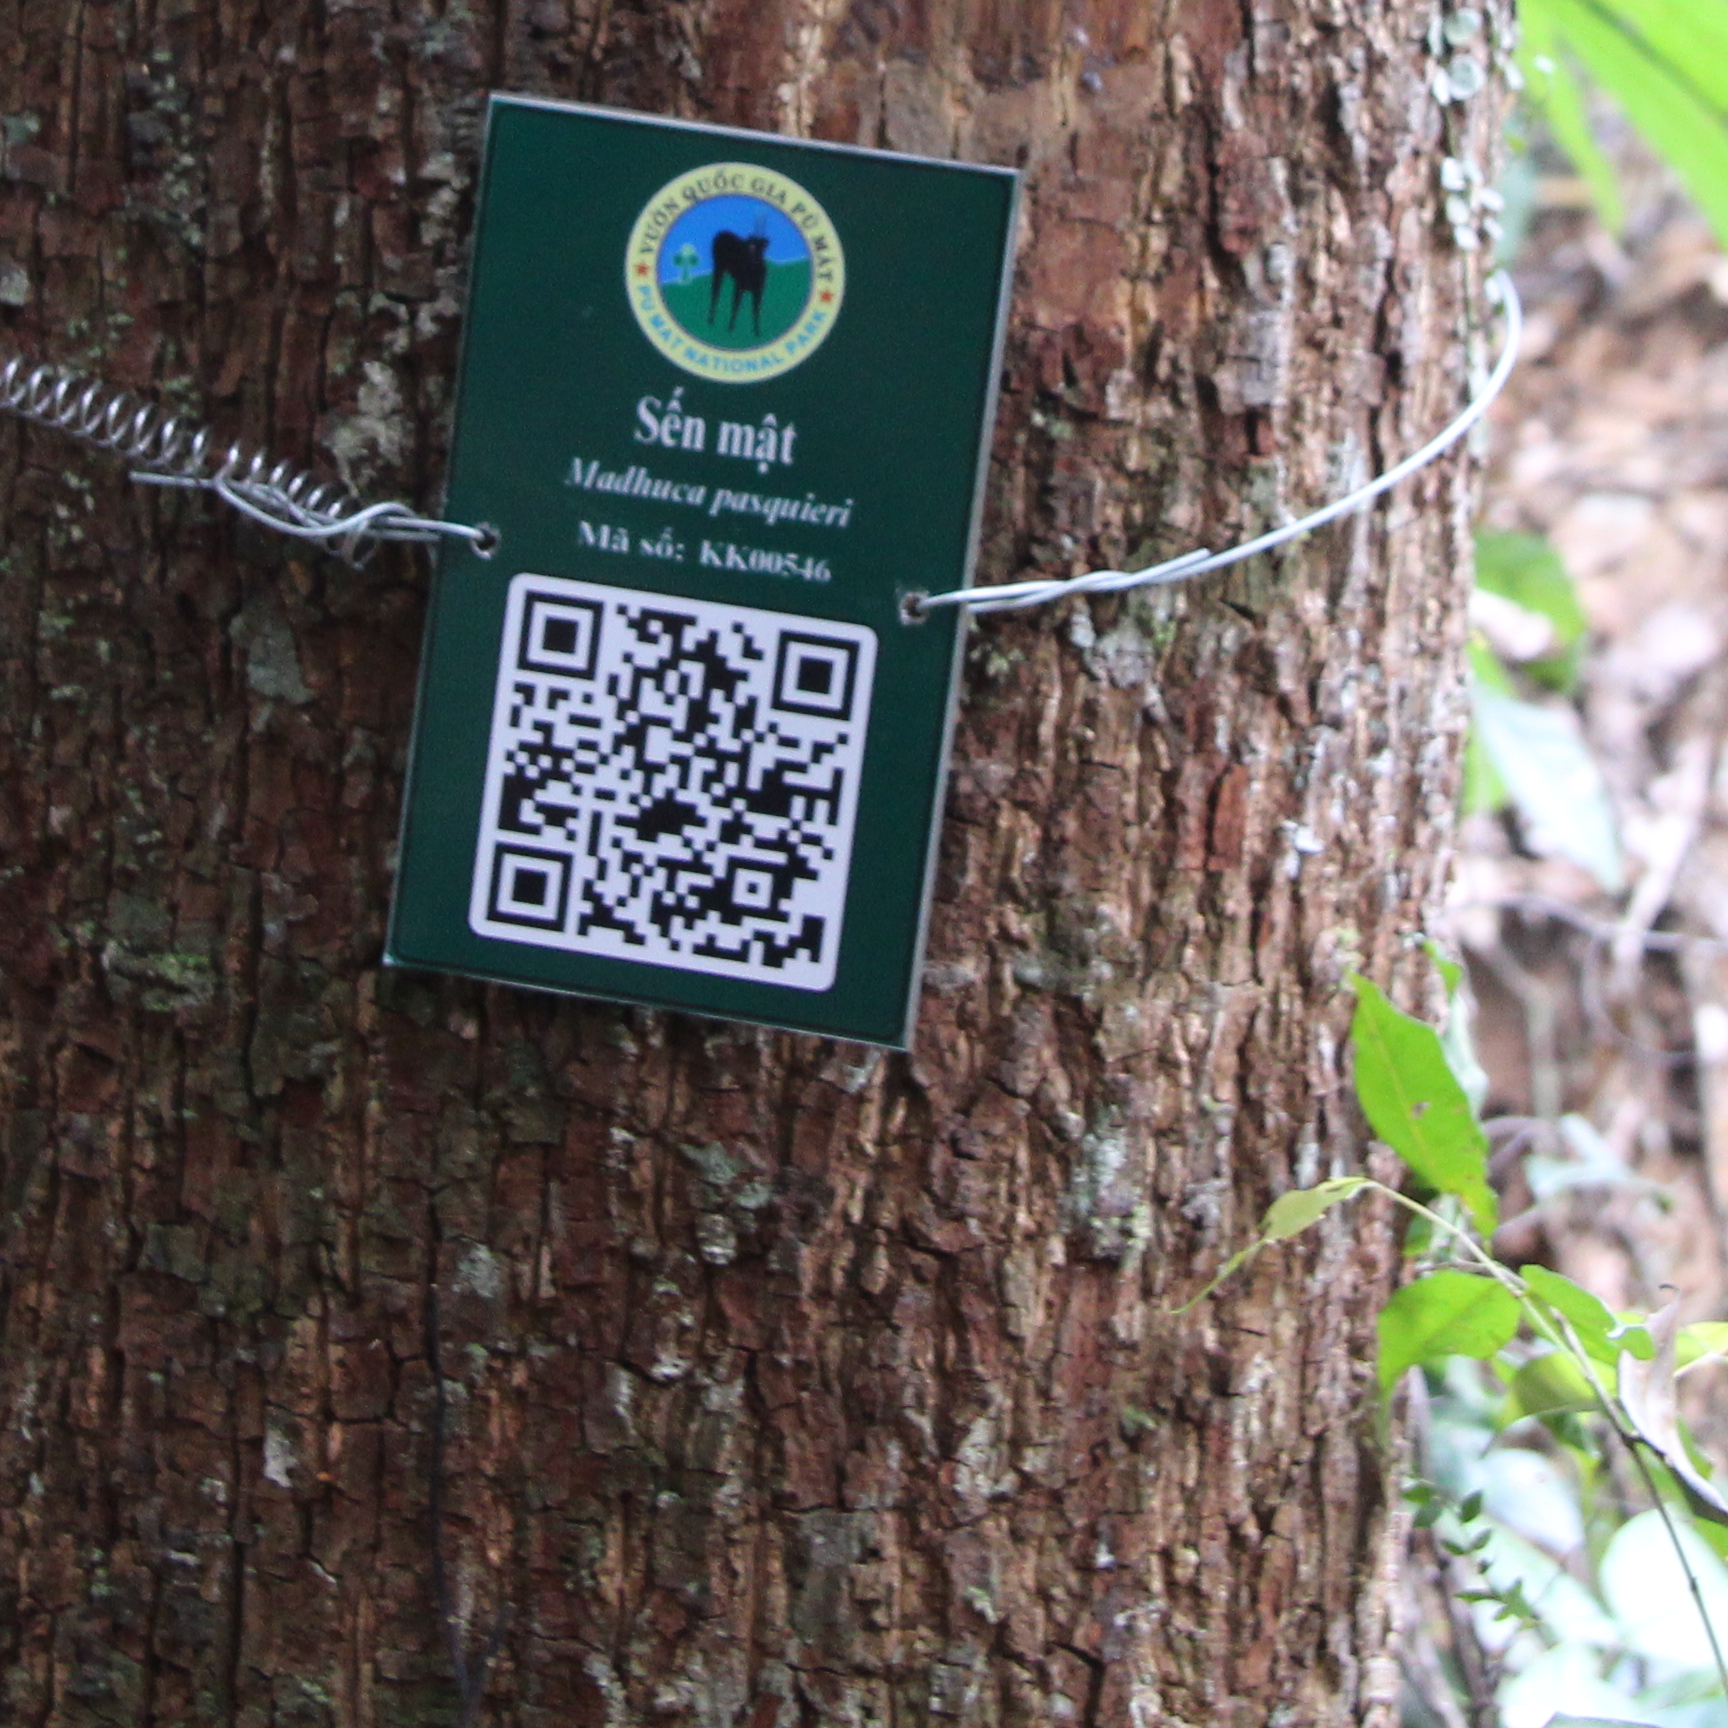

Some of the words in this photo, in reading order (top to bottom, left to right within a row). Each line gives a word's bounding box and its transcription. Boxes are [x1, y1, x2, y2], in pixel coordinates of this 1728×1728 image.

[682, 169, 746, 203] QUỐC
[751, 176, 787, 205] GIA
[649, 313, 683, 350] MAT
[683, 346, 784, 374] NATIONAL
[785, 309, 827, 355] PARK
[633, 385, 707, 452] Sến
[716, 412, 798, 475] mật
[564, 457, 708, 507] Madhuca
[708, 487, 855, 528] pasquieri
[578, 520, 630, 554] Mã
[639, 526, 686, 563] số:
[698, 538, 833, 584] KK00546
